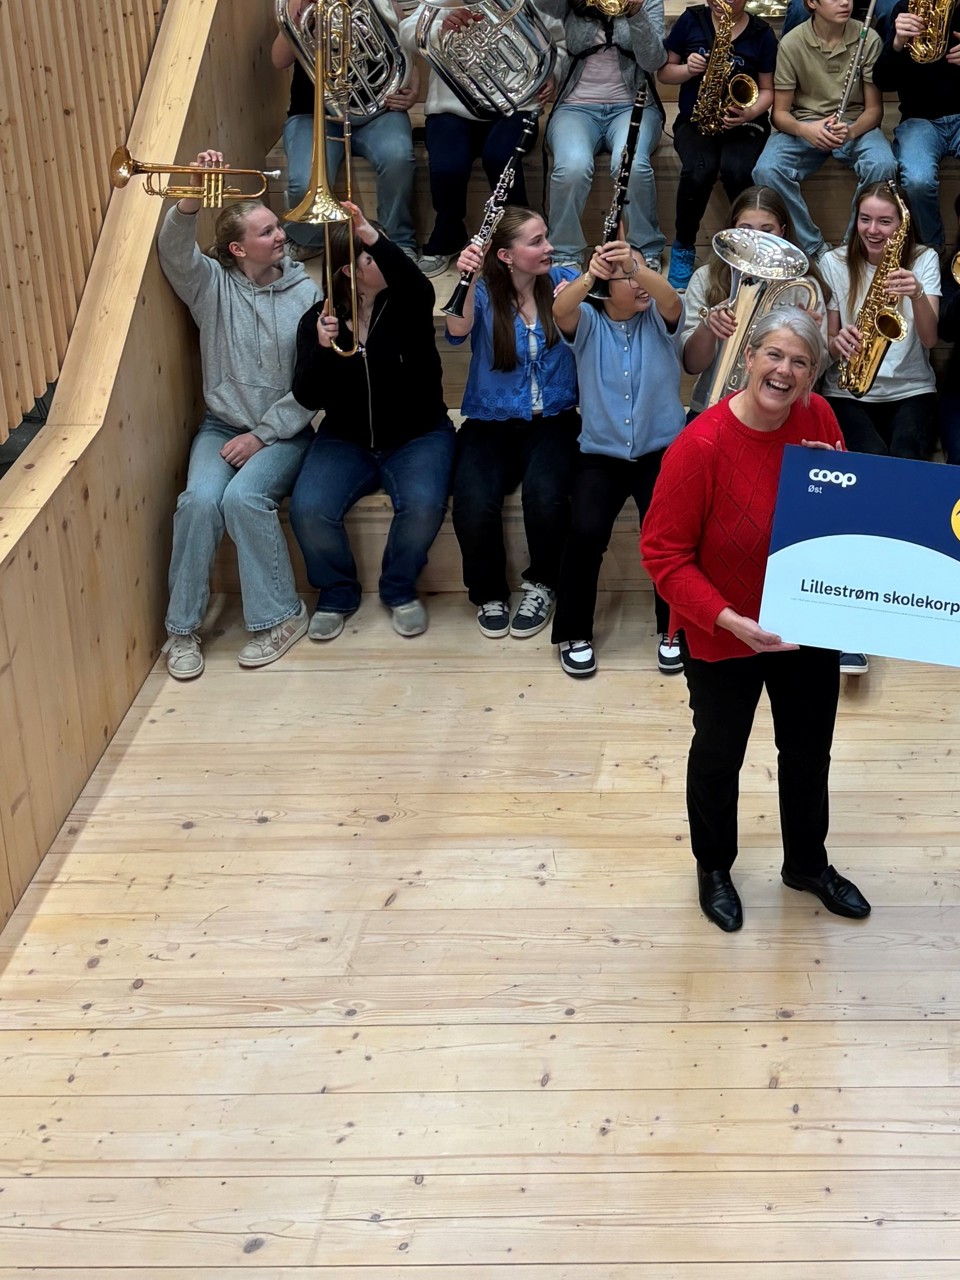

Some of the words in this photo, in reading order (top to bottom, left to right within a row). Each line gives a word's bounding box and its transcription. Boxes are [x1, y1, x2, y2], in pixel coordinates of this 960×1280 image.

[808, 468, 857, 488] coop
[807, 484, 823, 494] Øst
[800, 578, 880, 602] Lillestrøm
